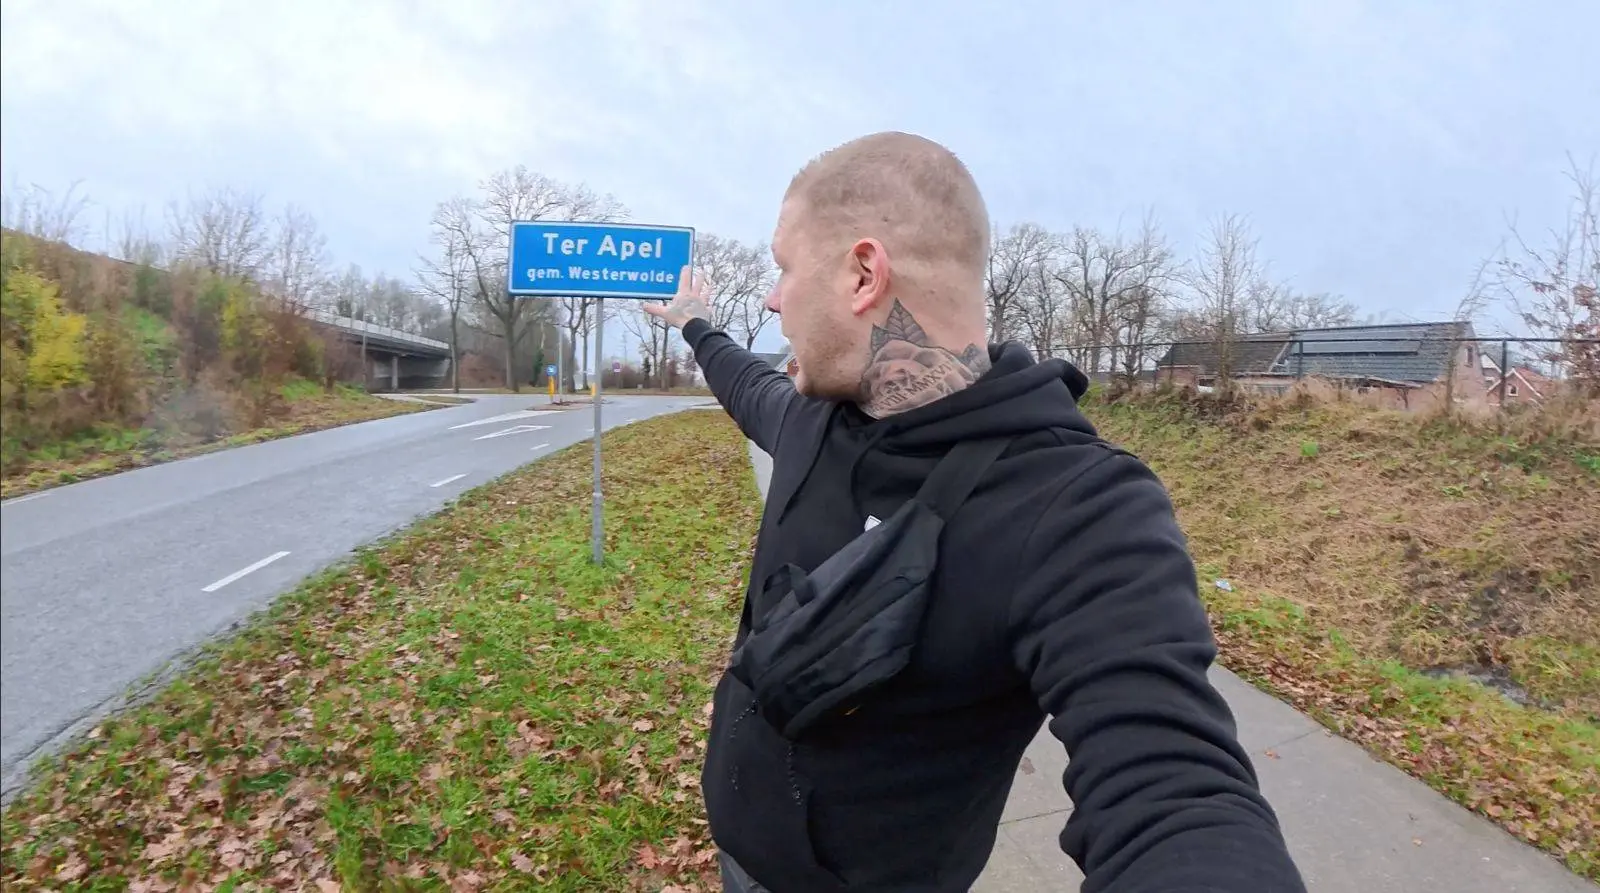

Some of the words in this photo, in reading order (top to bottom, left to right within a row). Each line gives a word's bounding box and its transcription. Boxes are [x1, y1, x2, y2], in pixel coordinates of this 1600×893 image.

[543, 232, 589, 255] Ter
[597, 234, 663, 261] Apel
[527, 268, 565, 282] gem.
[568, 266, 675, 284] Westerwolde
